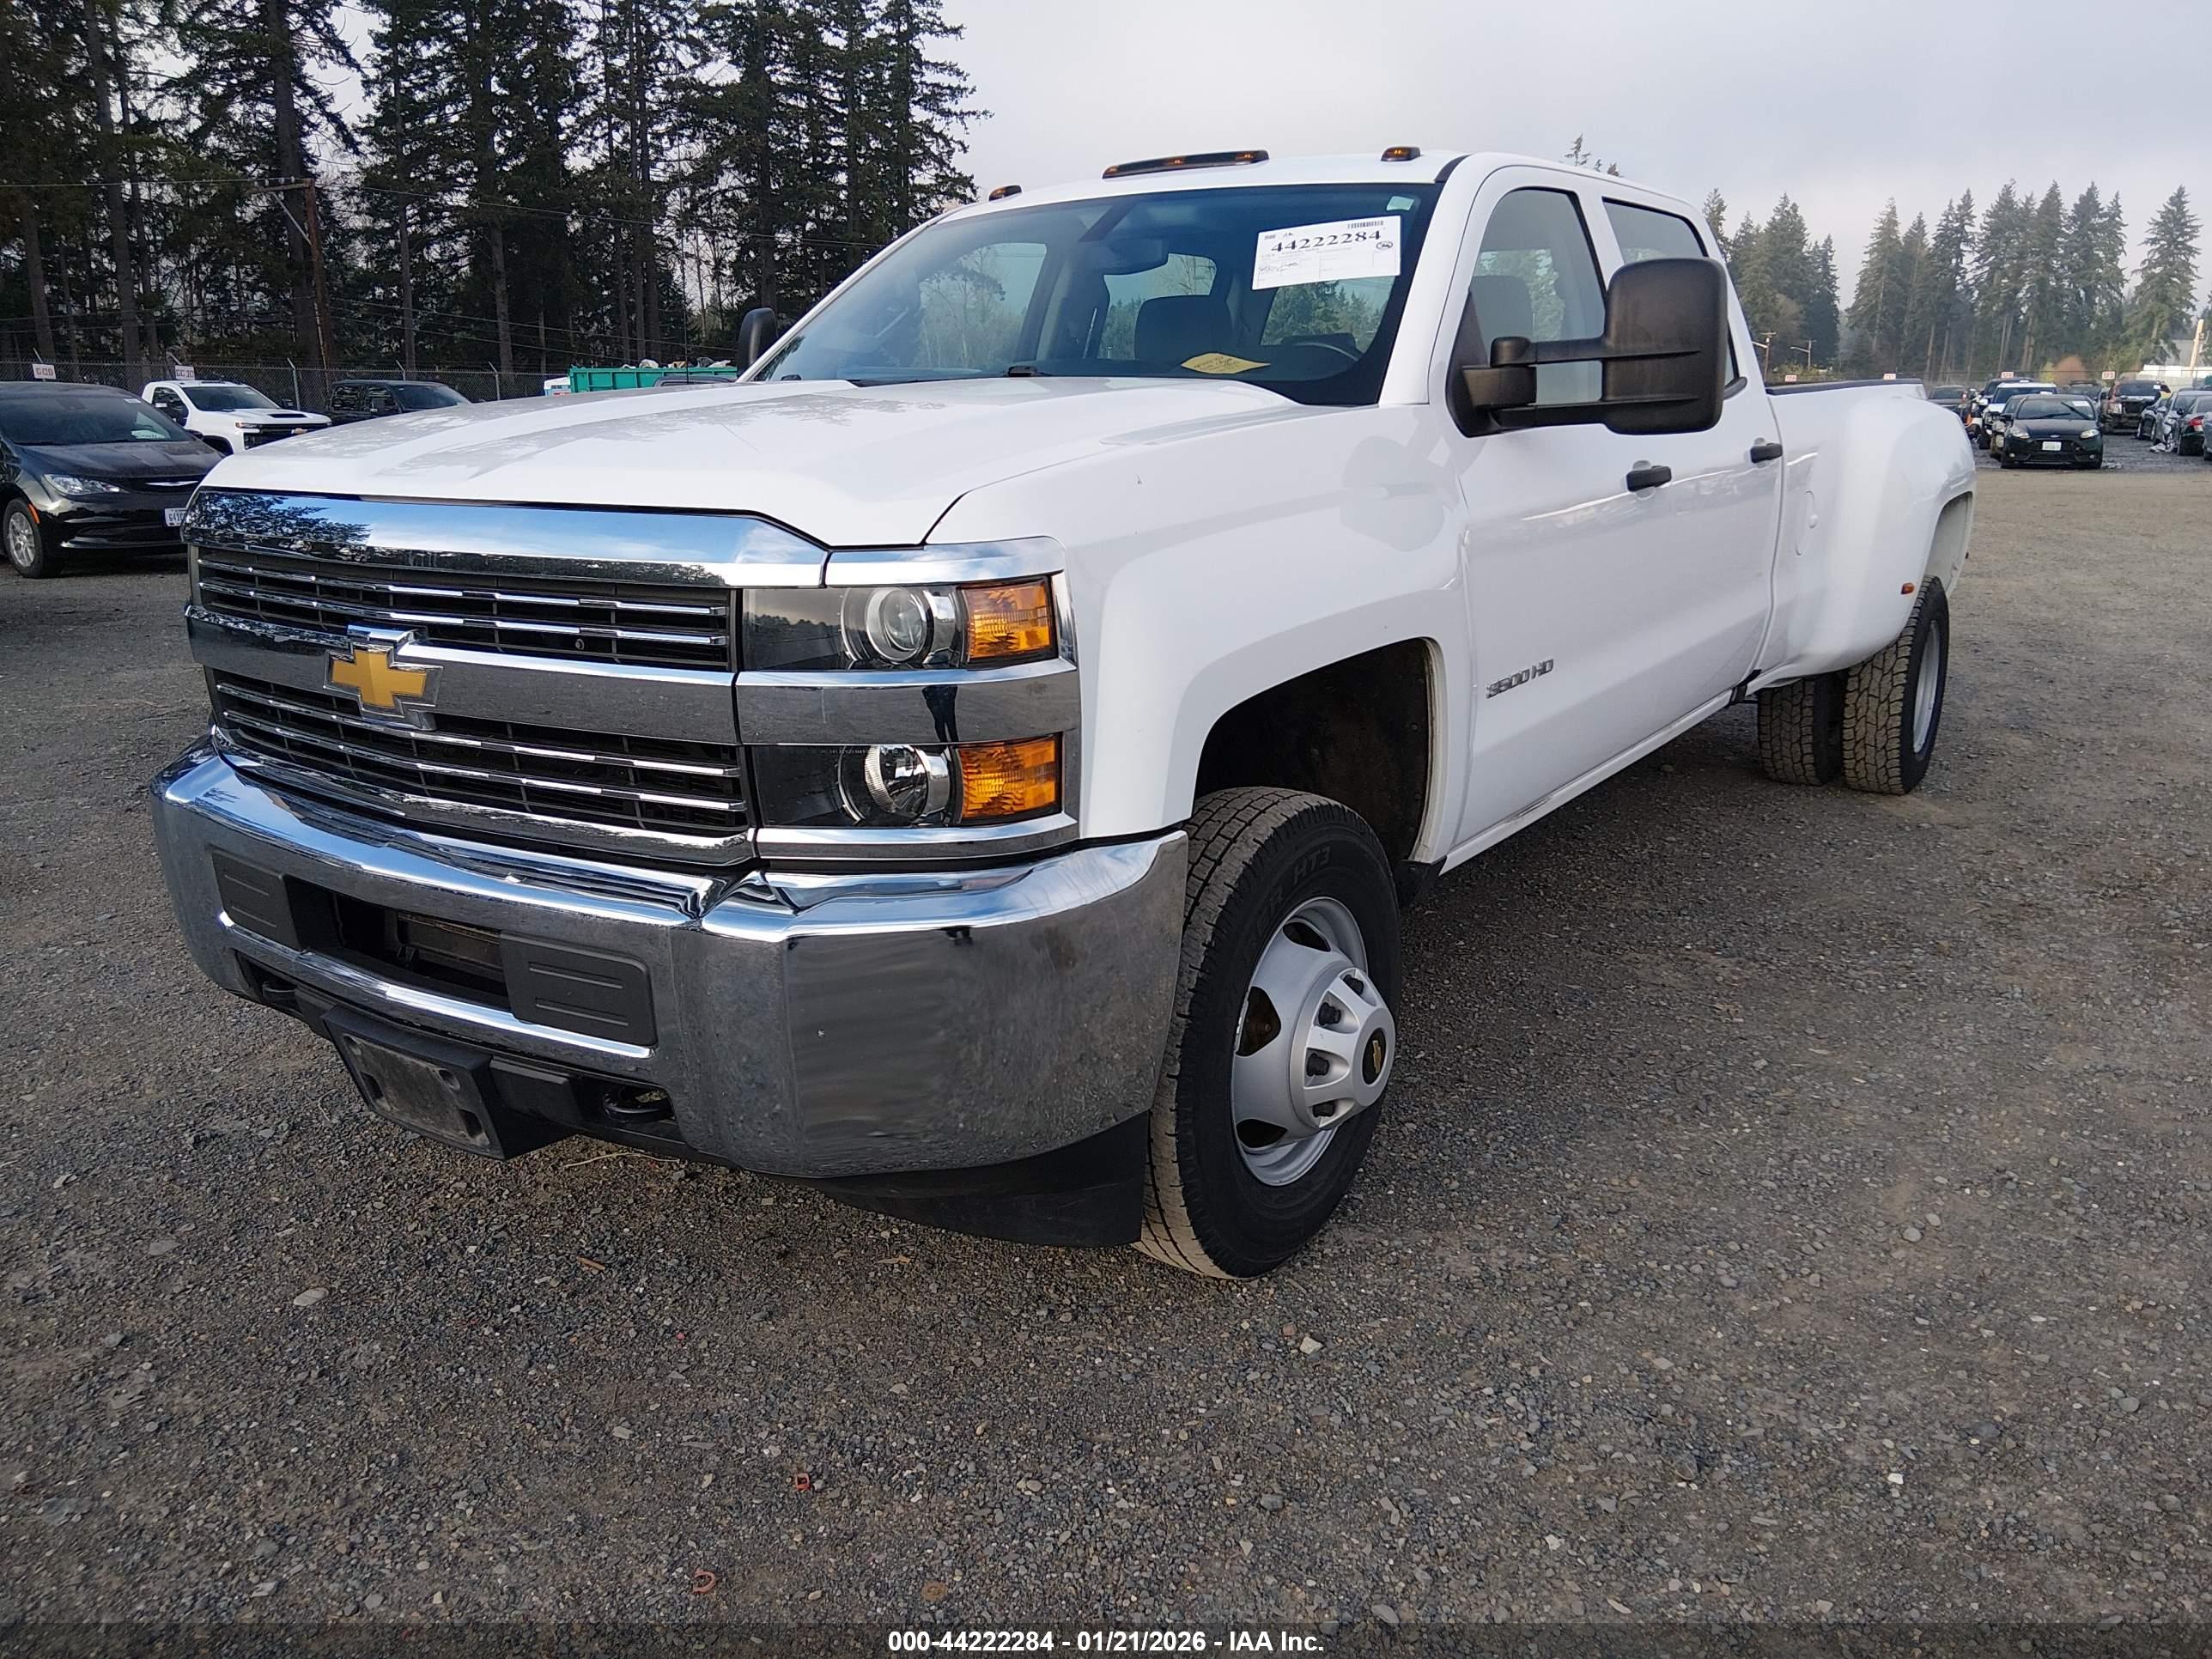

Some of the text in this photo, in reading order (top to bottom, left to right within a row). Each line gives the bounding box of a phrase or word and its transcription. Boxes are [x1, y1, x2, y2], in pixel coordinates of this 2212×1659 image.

[1271, 230, 1382, 252] 44222284
[1486, 659, 1554, 699] 3500 HD
[1293, 845, 1332, 885] HT3
